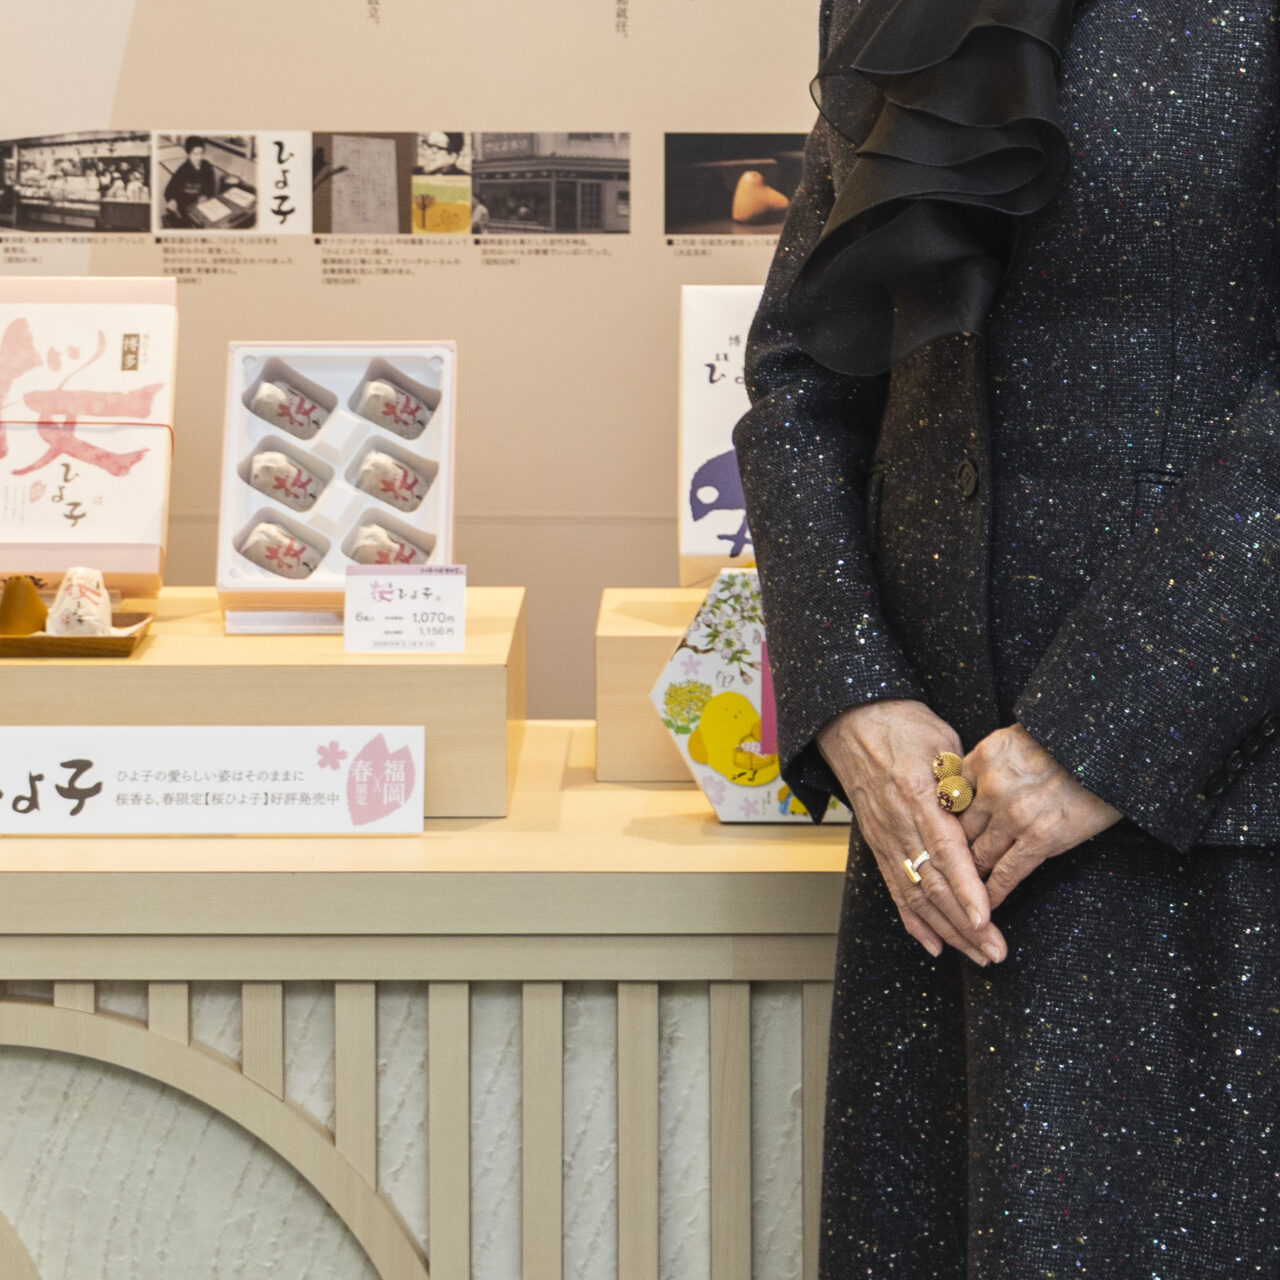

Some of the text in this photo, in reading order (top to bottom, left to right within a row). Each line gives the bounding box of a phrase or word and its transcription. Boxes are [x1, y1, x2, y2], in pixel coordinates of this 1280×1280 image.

[270, 140, 297, 225] ひよ子
[50, 463, 88, 528] ひよ子
[369, 580, 433, 603] 桜ひよ子
[412, 611, 456, 624] 1,070円
[115, 768, 305, 784] ひよ子の愛らしい姿はそのままに
[381, 759, 407, 806] 福岡
[114, 791, 341, 808] 桜香る、春限定【桜ひよ子】好評発売中
